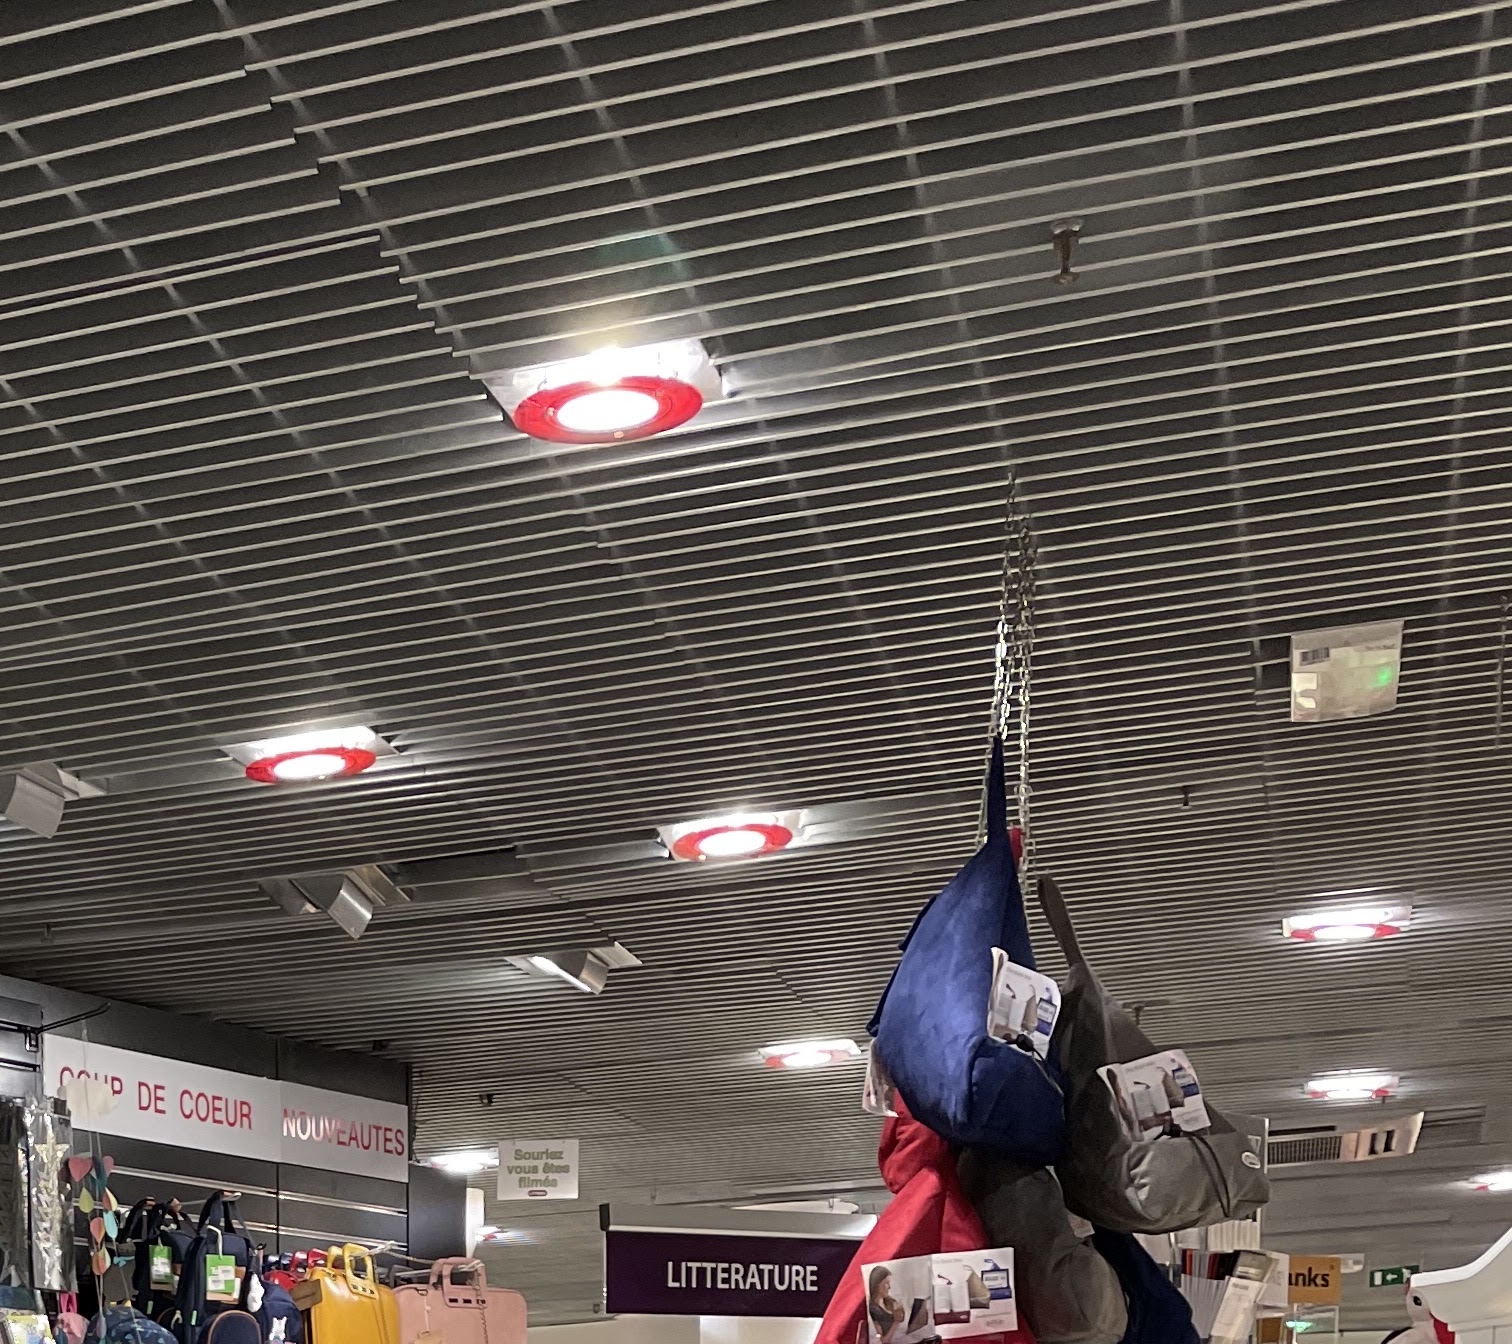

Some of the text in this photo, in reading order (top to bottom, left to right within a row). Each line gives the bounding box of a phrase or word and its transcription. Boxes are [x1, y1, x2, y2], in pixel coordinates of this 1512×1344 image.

[138, 1081, 166, 1114] DE
[179, 1089, 253, 1131] COEUR
[282, 1107, 406, 1157] NOUVEAUTES
[667, 1261, 819, 1292] LITTERATURE
